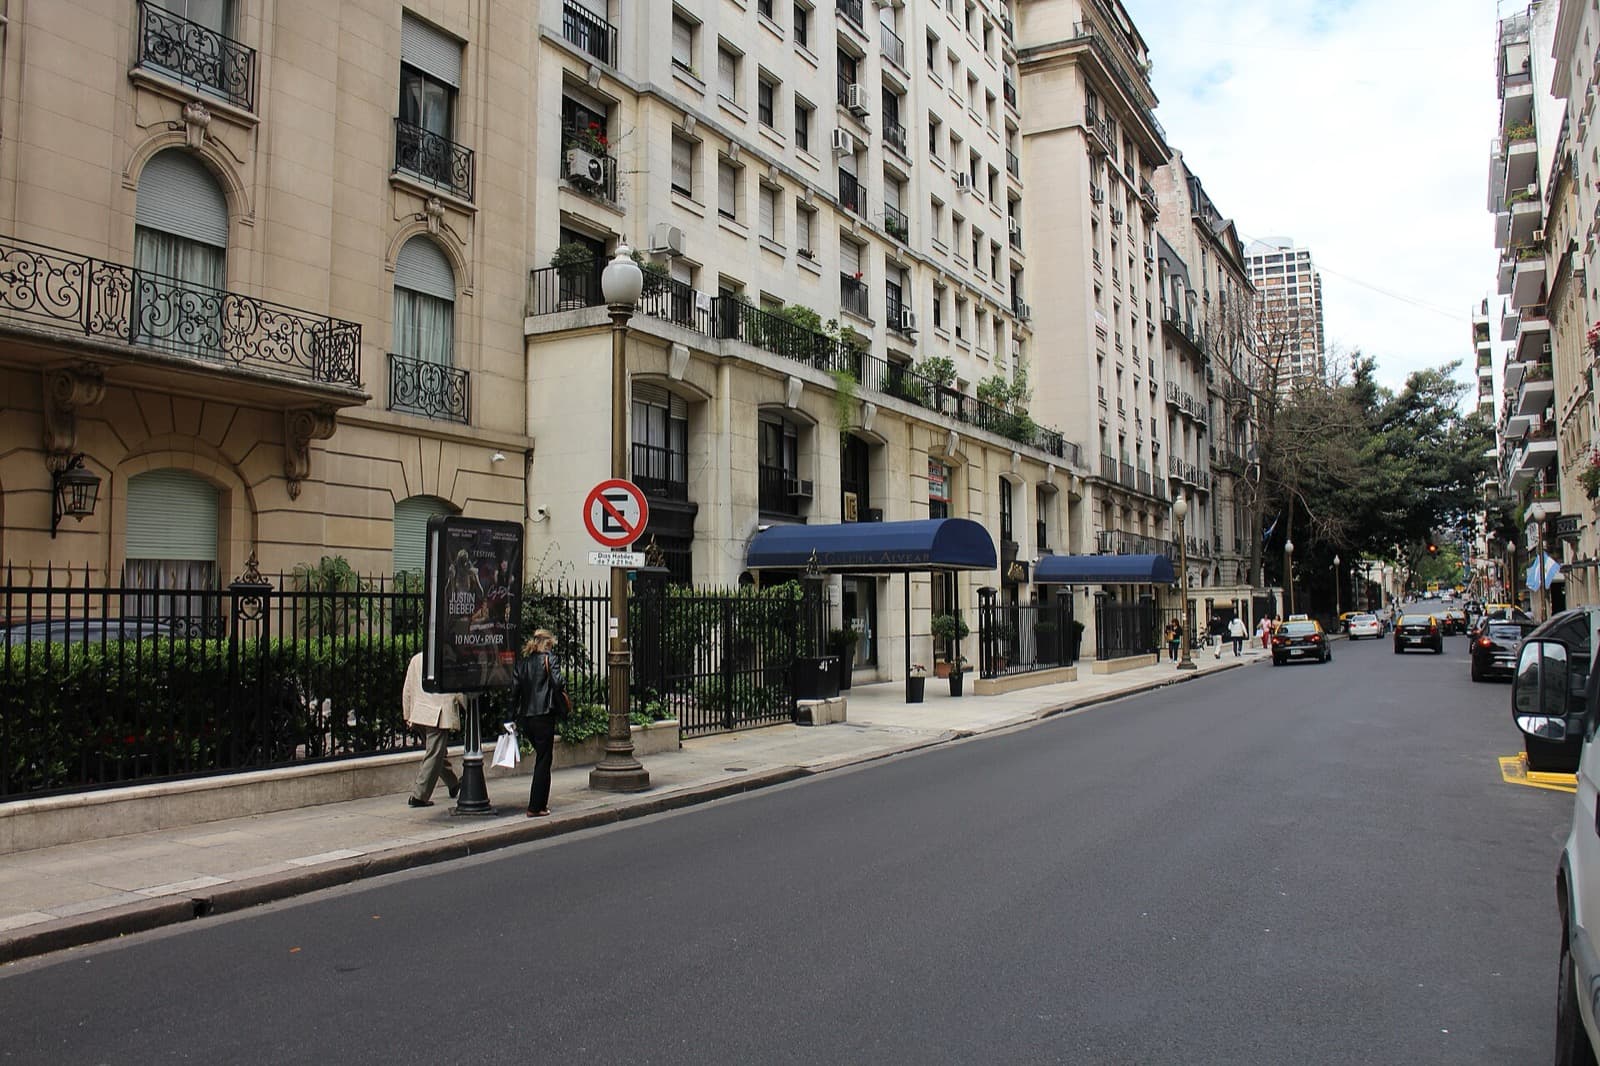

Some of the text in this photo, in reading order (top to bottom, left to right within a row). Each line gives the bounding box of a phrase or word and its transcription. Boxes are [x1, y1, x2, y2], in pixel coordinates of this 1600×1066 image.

[449, 591, 475, 603] JUSTIN
[449, 603, 475, 614] BIEBER
[455, 634, 504, 645] 10 NOV RIVER
